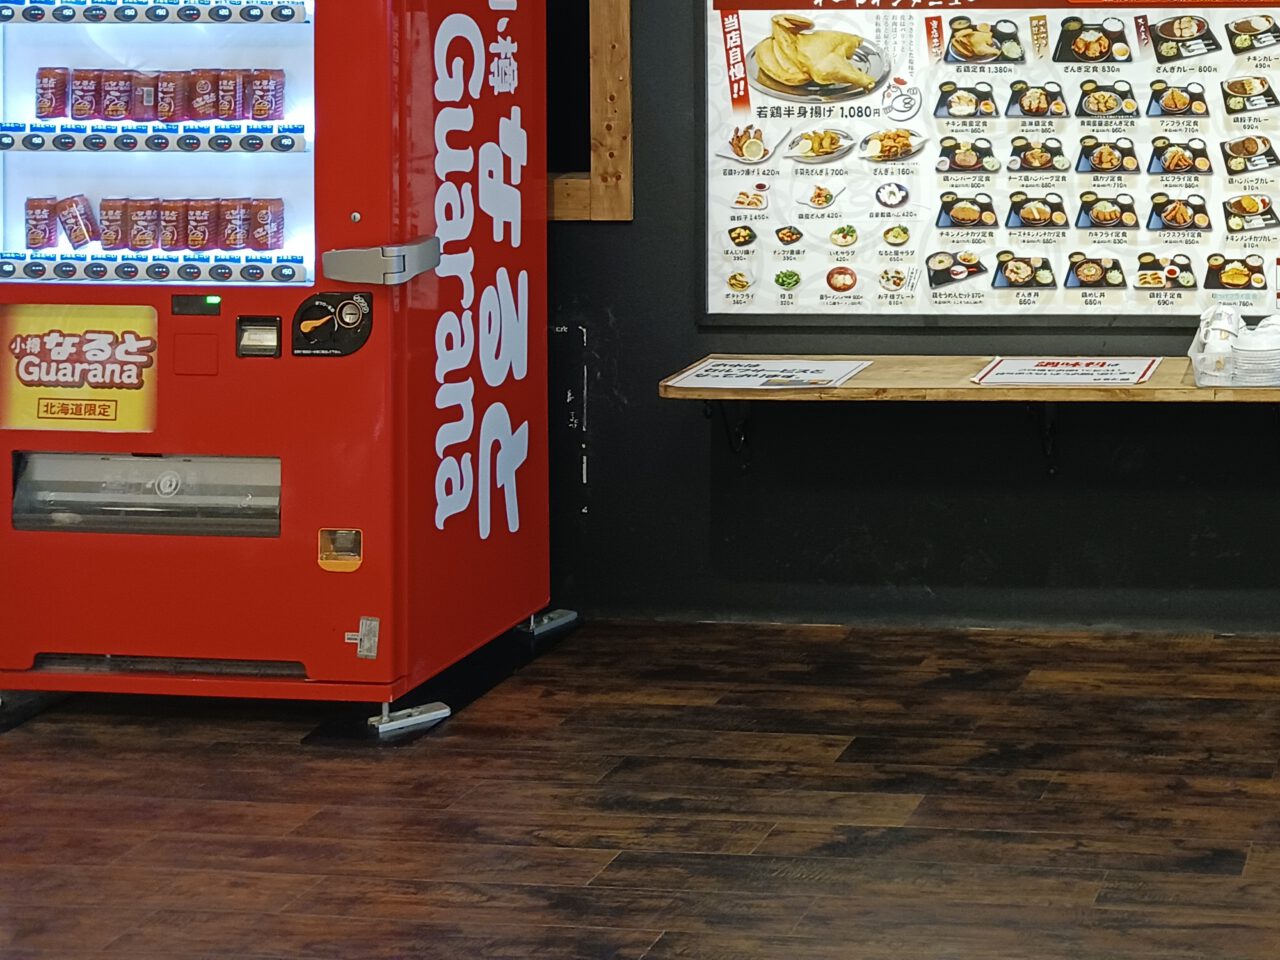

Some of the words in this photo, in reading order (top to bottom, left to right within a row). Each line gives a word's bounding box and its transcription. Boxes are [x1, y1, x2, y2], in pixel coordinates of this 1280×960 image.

[756, 105, 834, 119] 若鶏半身揚げ
[434, 13, 485, 530] Guarana
[478, 106, 528, 539] なると
[44, 333, 151, 362] なると
[19, 355, 139, 383] Guarana
[43, 402, 111, 417] 北海道限定
